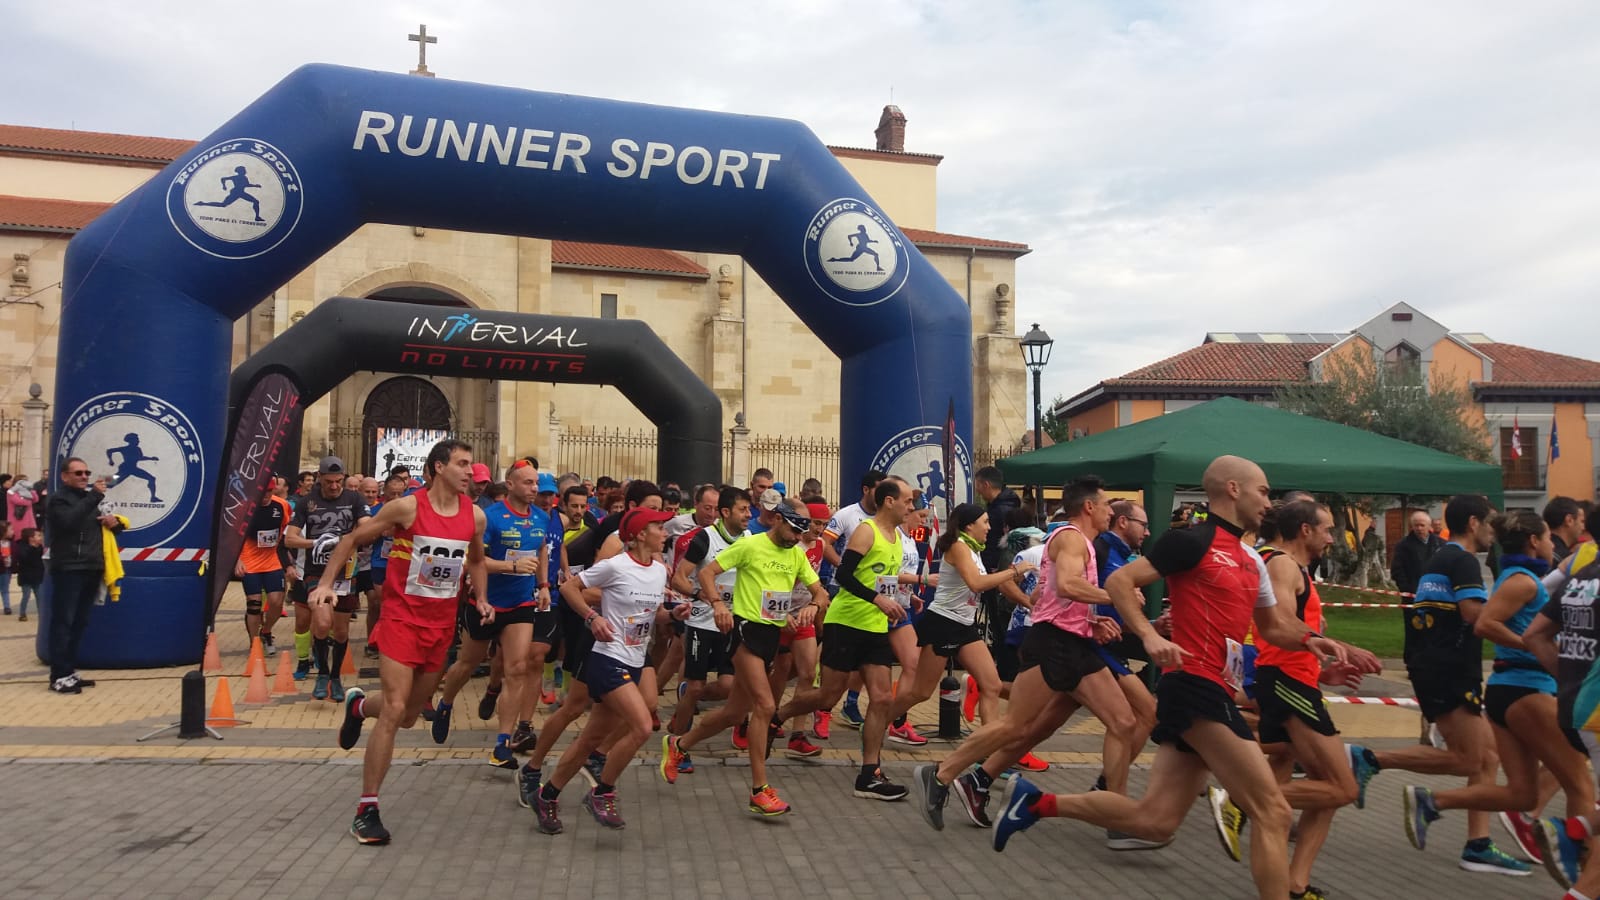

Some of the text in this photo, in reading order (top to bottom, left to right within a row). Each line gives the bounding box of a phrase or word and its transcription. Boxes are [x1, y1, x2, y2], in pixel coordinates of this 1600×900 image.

[353, 110, 781, 190] RUNNER SPORT
[175, 142, 299, 193] Runner Sport
[808, 202, 902, 248] Runner Sport
[407, 313, 588, 347] INTERVAL
[400, 351, 585, 373] NO LIMITS
[59, 400, 200, 464] Runner Sport
[223, 387, 283, 527] INTERVAL
[396, 453, 428, 462] Carre
[955, 442, 972, 487] port
[432, 566, 451, 578] 85
[880, 583, 896, 595] 217
[767, 599, 789, 611] 216
[636, 622, 650, 636] 79
